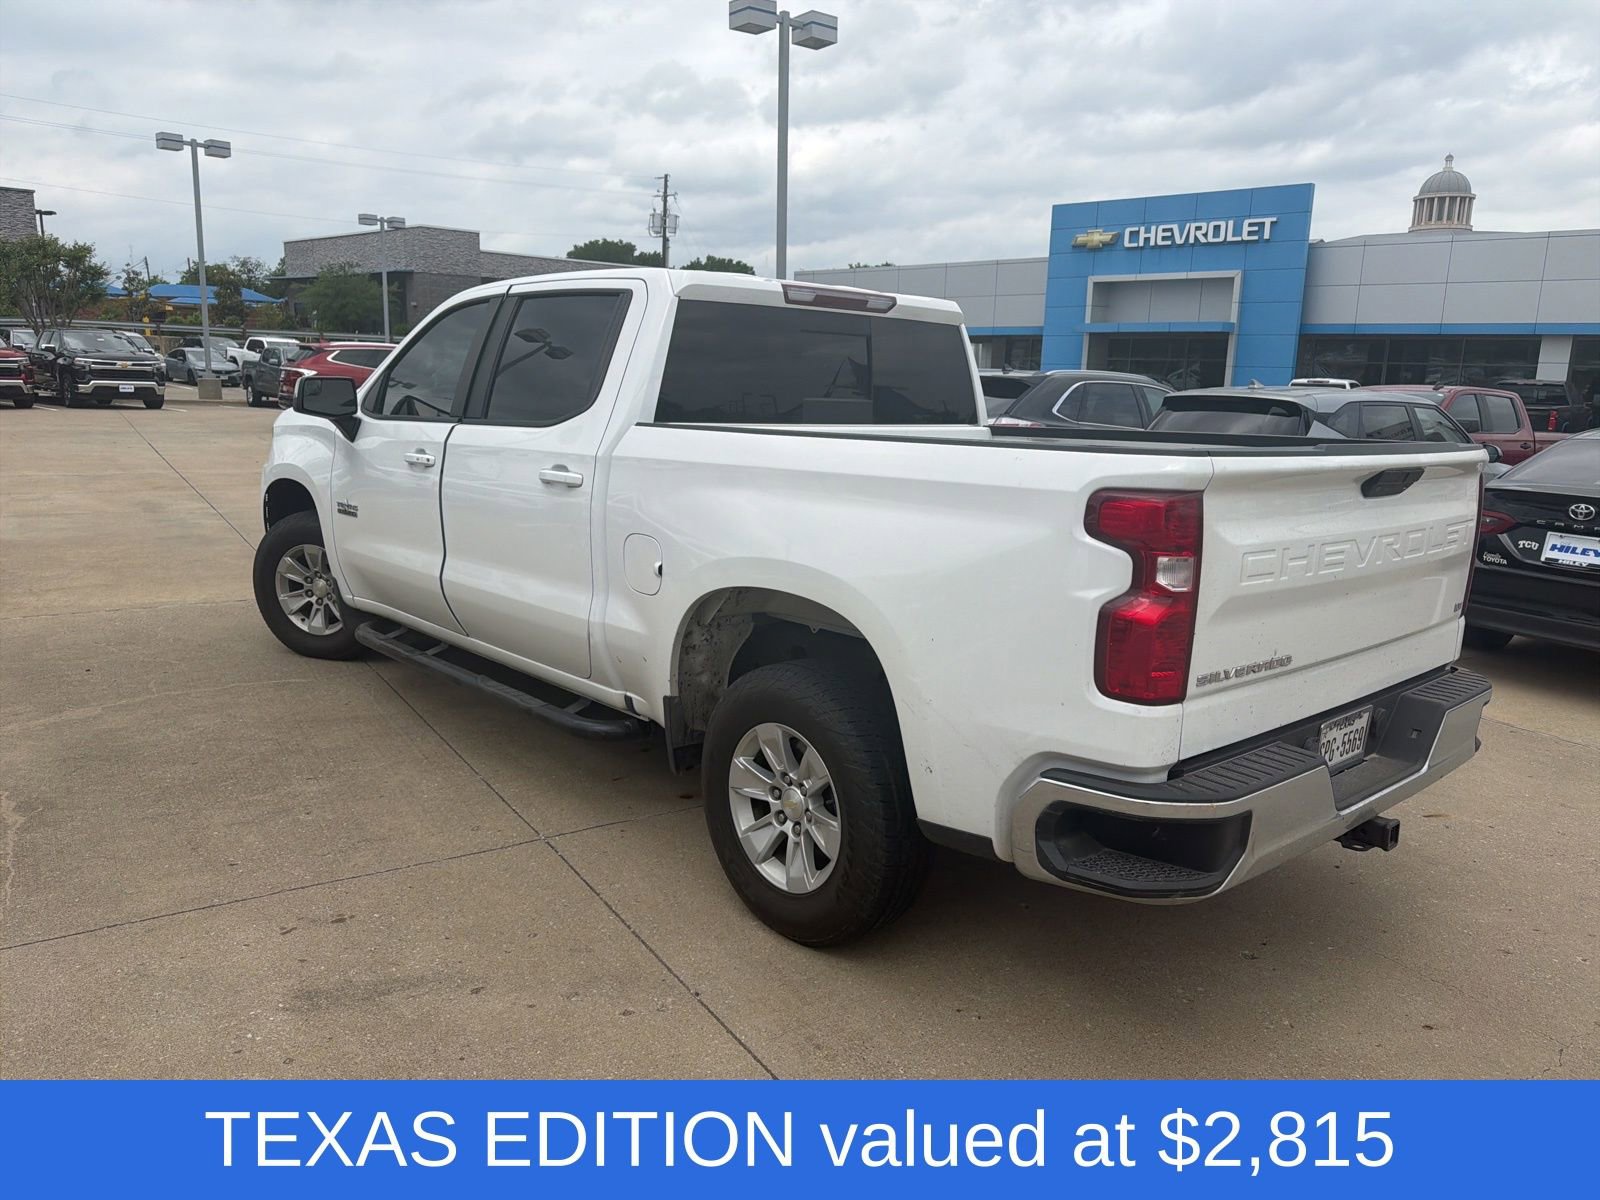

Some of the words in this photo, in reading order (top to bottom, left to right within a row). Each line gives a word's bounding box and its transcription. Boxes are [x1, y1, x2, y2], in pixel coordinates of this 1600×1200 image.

[1124, 217, 1278, 248] CHEVROLET
[1239, 518, 1474, 586] CHEVROLET
[1518, 540, 1540, 551] TCU
[1549, 543, 1600, 558] HILEY
[1482, 555, 1508, 565] TOYOTA
[1557, 559, 1589, 567] HILEY
